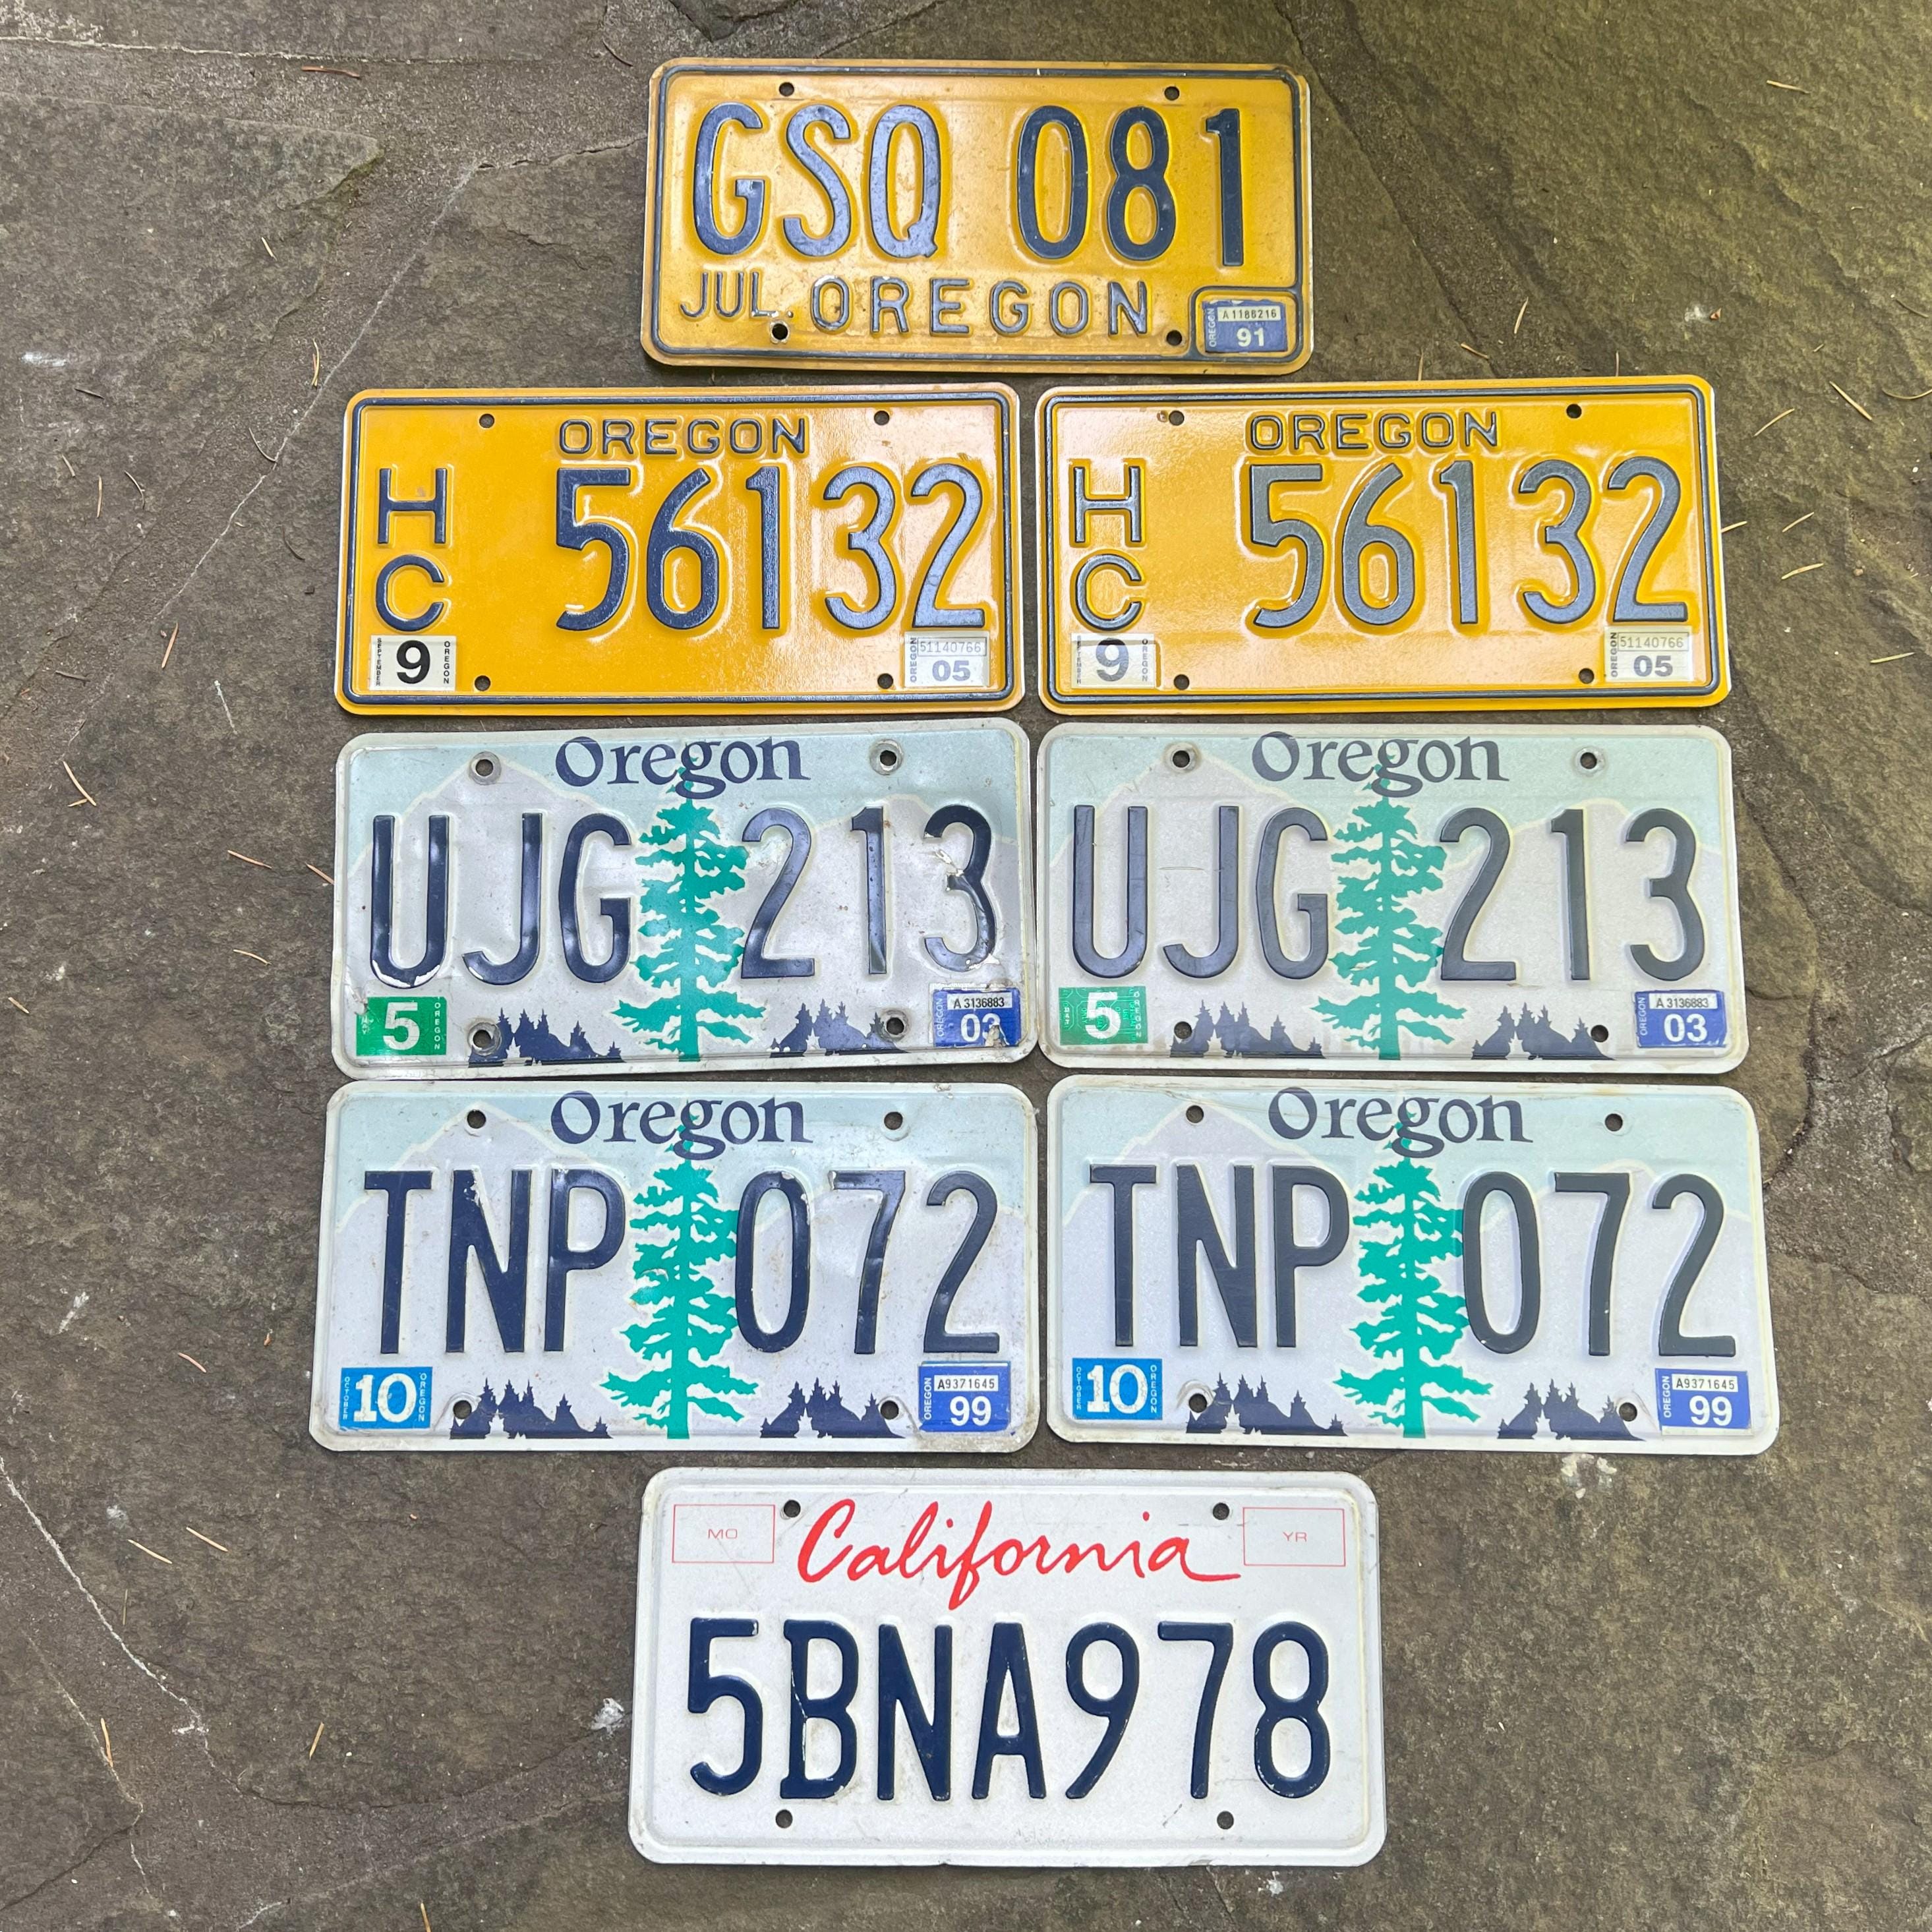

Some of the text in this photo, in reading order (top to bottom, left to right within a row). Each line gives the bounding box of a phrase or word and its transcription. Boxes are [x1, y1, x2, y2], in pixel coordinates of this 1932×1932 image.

[693, 103, 1244, 267] GSQ 081
[811, 274, 1149, 337] OREGON
[1207, 308, 1217, 347] OREGON
[1237, 328, 1264, 347] 91
[558, 418, 806, 455] OREGON
[1250, 410, 1499, 451] OREGON
[556, 464, 985, 631] 56132
[1248, 457, 1688, 628] 56132
[396, 640, 430, 684] 9
[920, 641, 981, 653] 51140766
[1096, 637, 1129, 682] 9
[1610, 632, 1618, 678] OREGON
[1620, 636, 1684, 648] 51140766
[932, 660, 971, 682] 05
[1633, 655, 1674, 677] 05
[555, 736, 810, 800] Oregon
[1252, 730, 1509, 798] Oregon
[369, 804, 997, 988] UJG 213
[1072, 804, 1706, 983] UJG 213
[383, 1001, 420, 1050] 5
[935, 997, 944, 1037] OREGON
[1085, 991, 1121, 1039] 5
[1638, 997, 1647, 1036] OREGON
[1664, 1013, 1708, 1042] 03
[551, 1090, 813, 1161] Oregon
[1268, 1087, 1533, 1159] Oregon
[363, 1168, 1001, 1356] TNP 072
[1089, 1163, 1737, 1359] TNP 072
[353, 1373, 417, 1422] 10
[418, 1372, 427, 1422] OREGON
[923, 1377, 932, 1420] OREGON
[937, 1378, 995, 1390] A9371645
[1087, 1364, 1148, 1414] 10
[1662, 1376, 1672, 1419] OREGON
[1676, 1378, 1735, 1390] A9371645
[950, 1395, 991, 1426] 99
[1689, 1395, 1732, 1426] 99
[708, 1529, 738, 1539] MO
[797, 1499, 1241, 1610] California
[1283, 1532, 1307, 1542] YR
[688, 1617, 1330, 1801] 5BNA978
